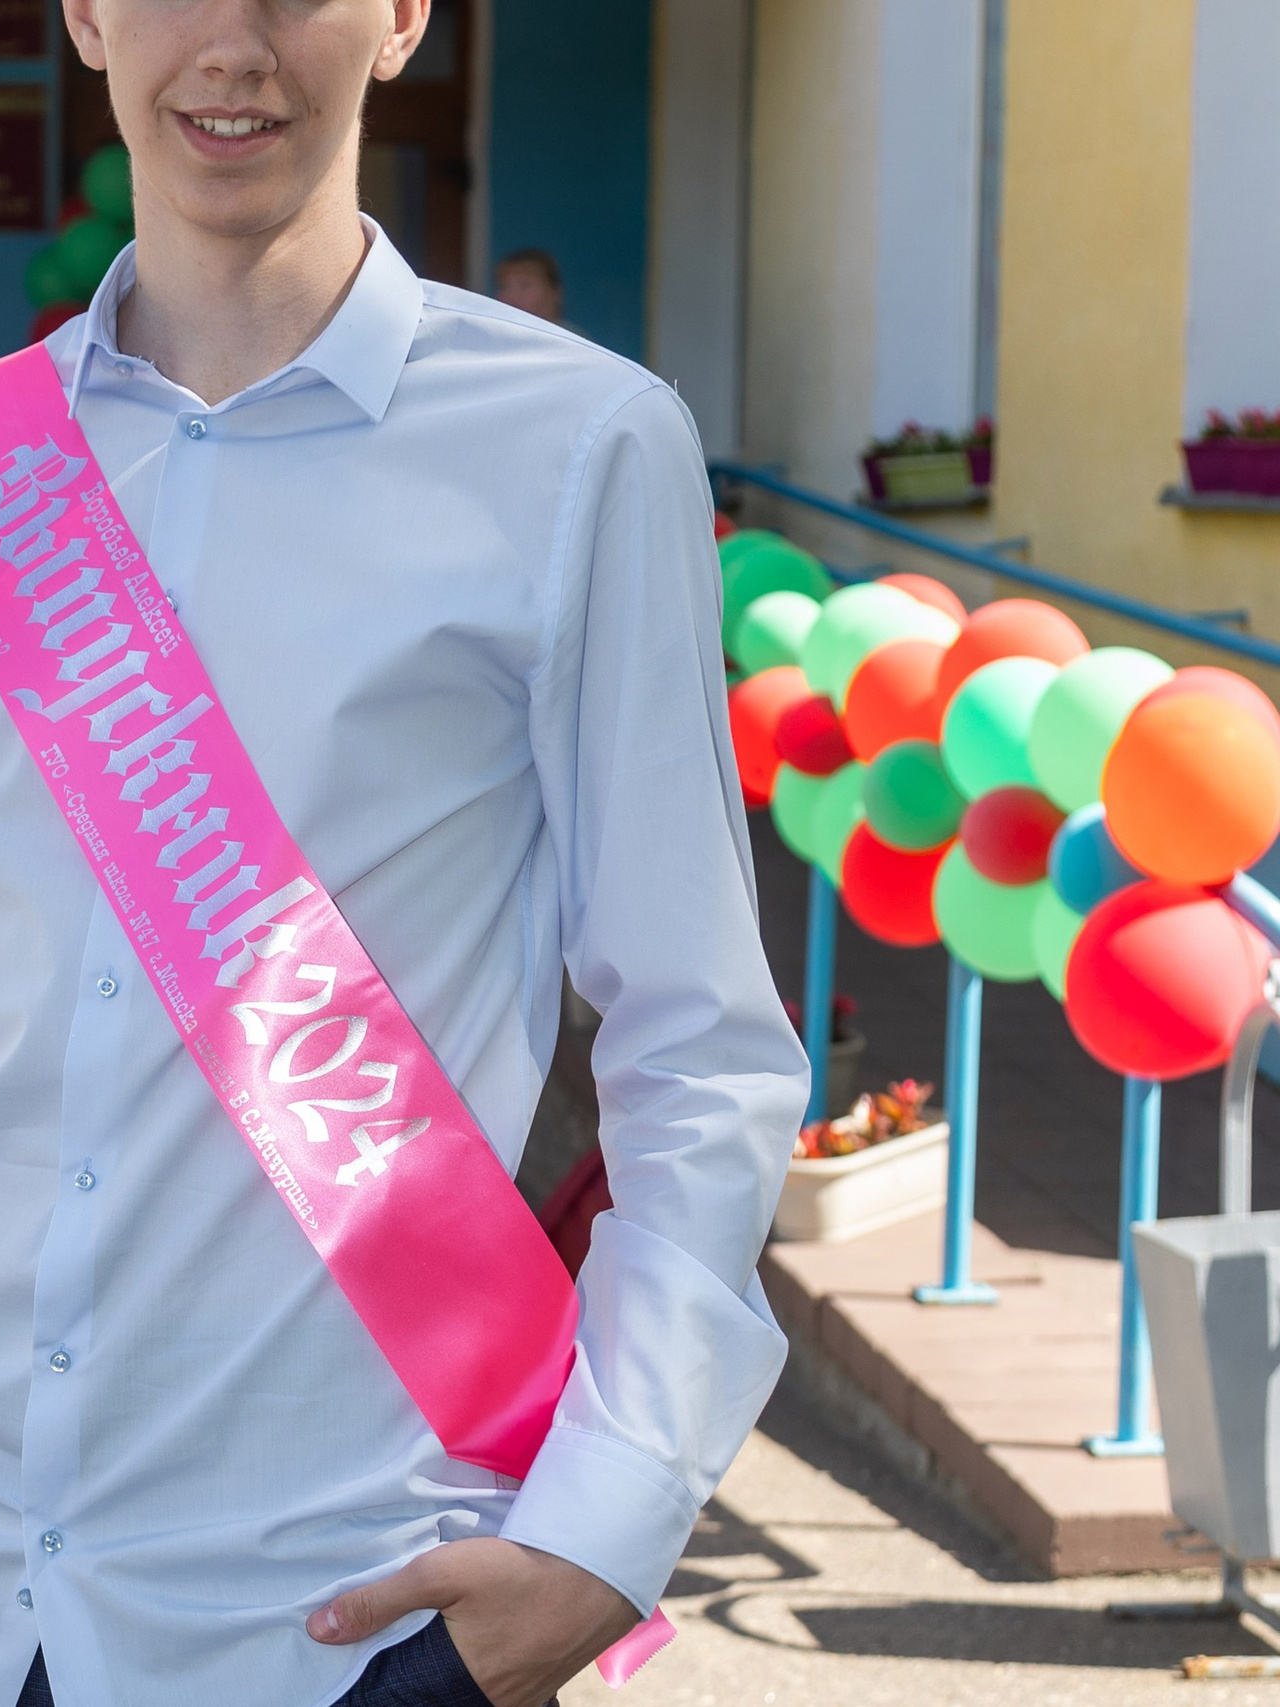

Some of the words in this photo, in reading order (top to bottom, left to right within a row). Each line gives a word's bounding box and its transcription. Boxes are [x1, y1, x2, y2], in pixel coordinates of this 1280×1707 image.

[79, 480, 140, 571] Воробьев
[123, 571, 183, 659] Алексей
[39, 742, 70, 779] ГУО
[63, 784, 110, 863] «Средняя
[102, 861, 136, 914] школа
[128, 910, 161, 949] N47
[149, 952, 198, 1035] г.Минска
[228, 963, 431, 1188] 2024
